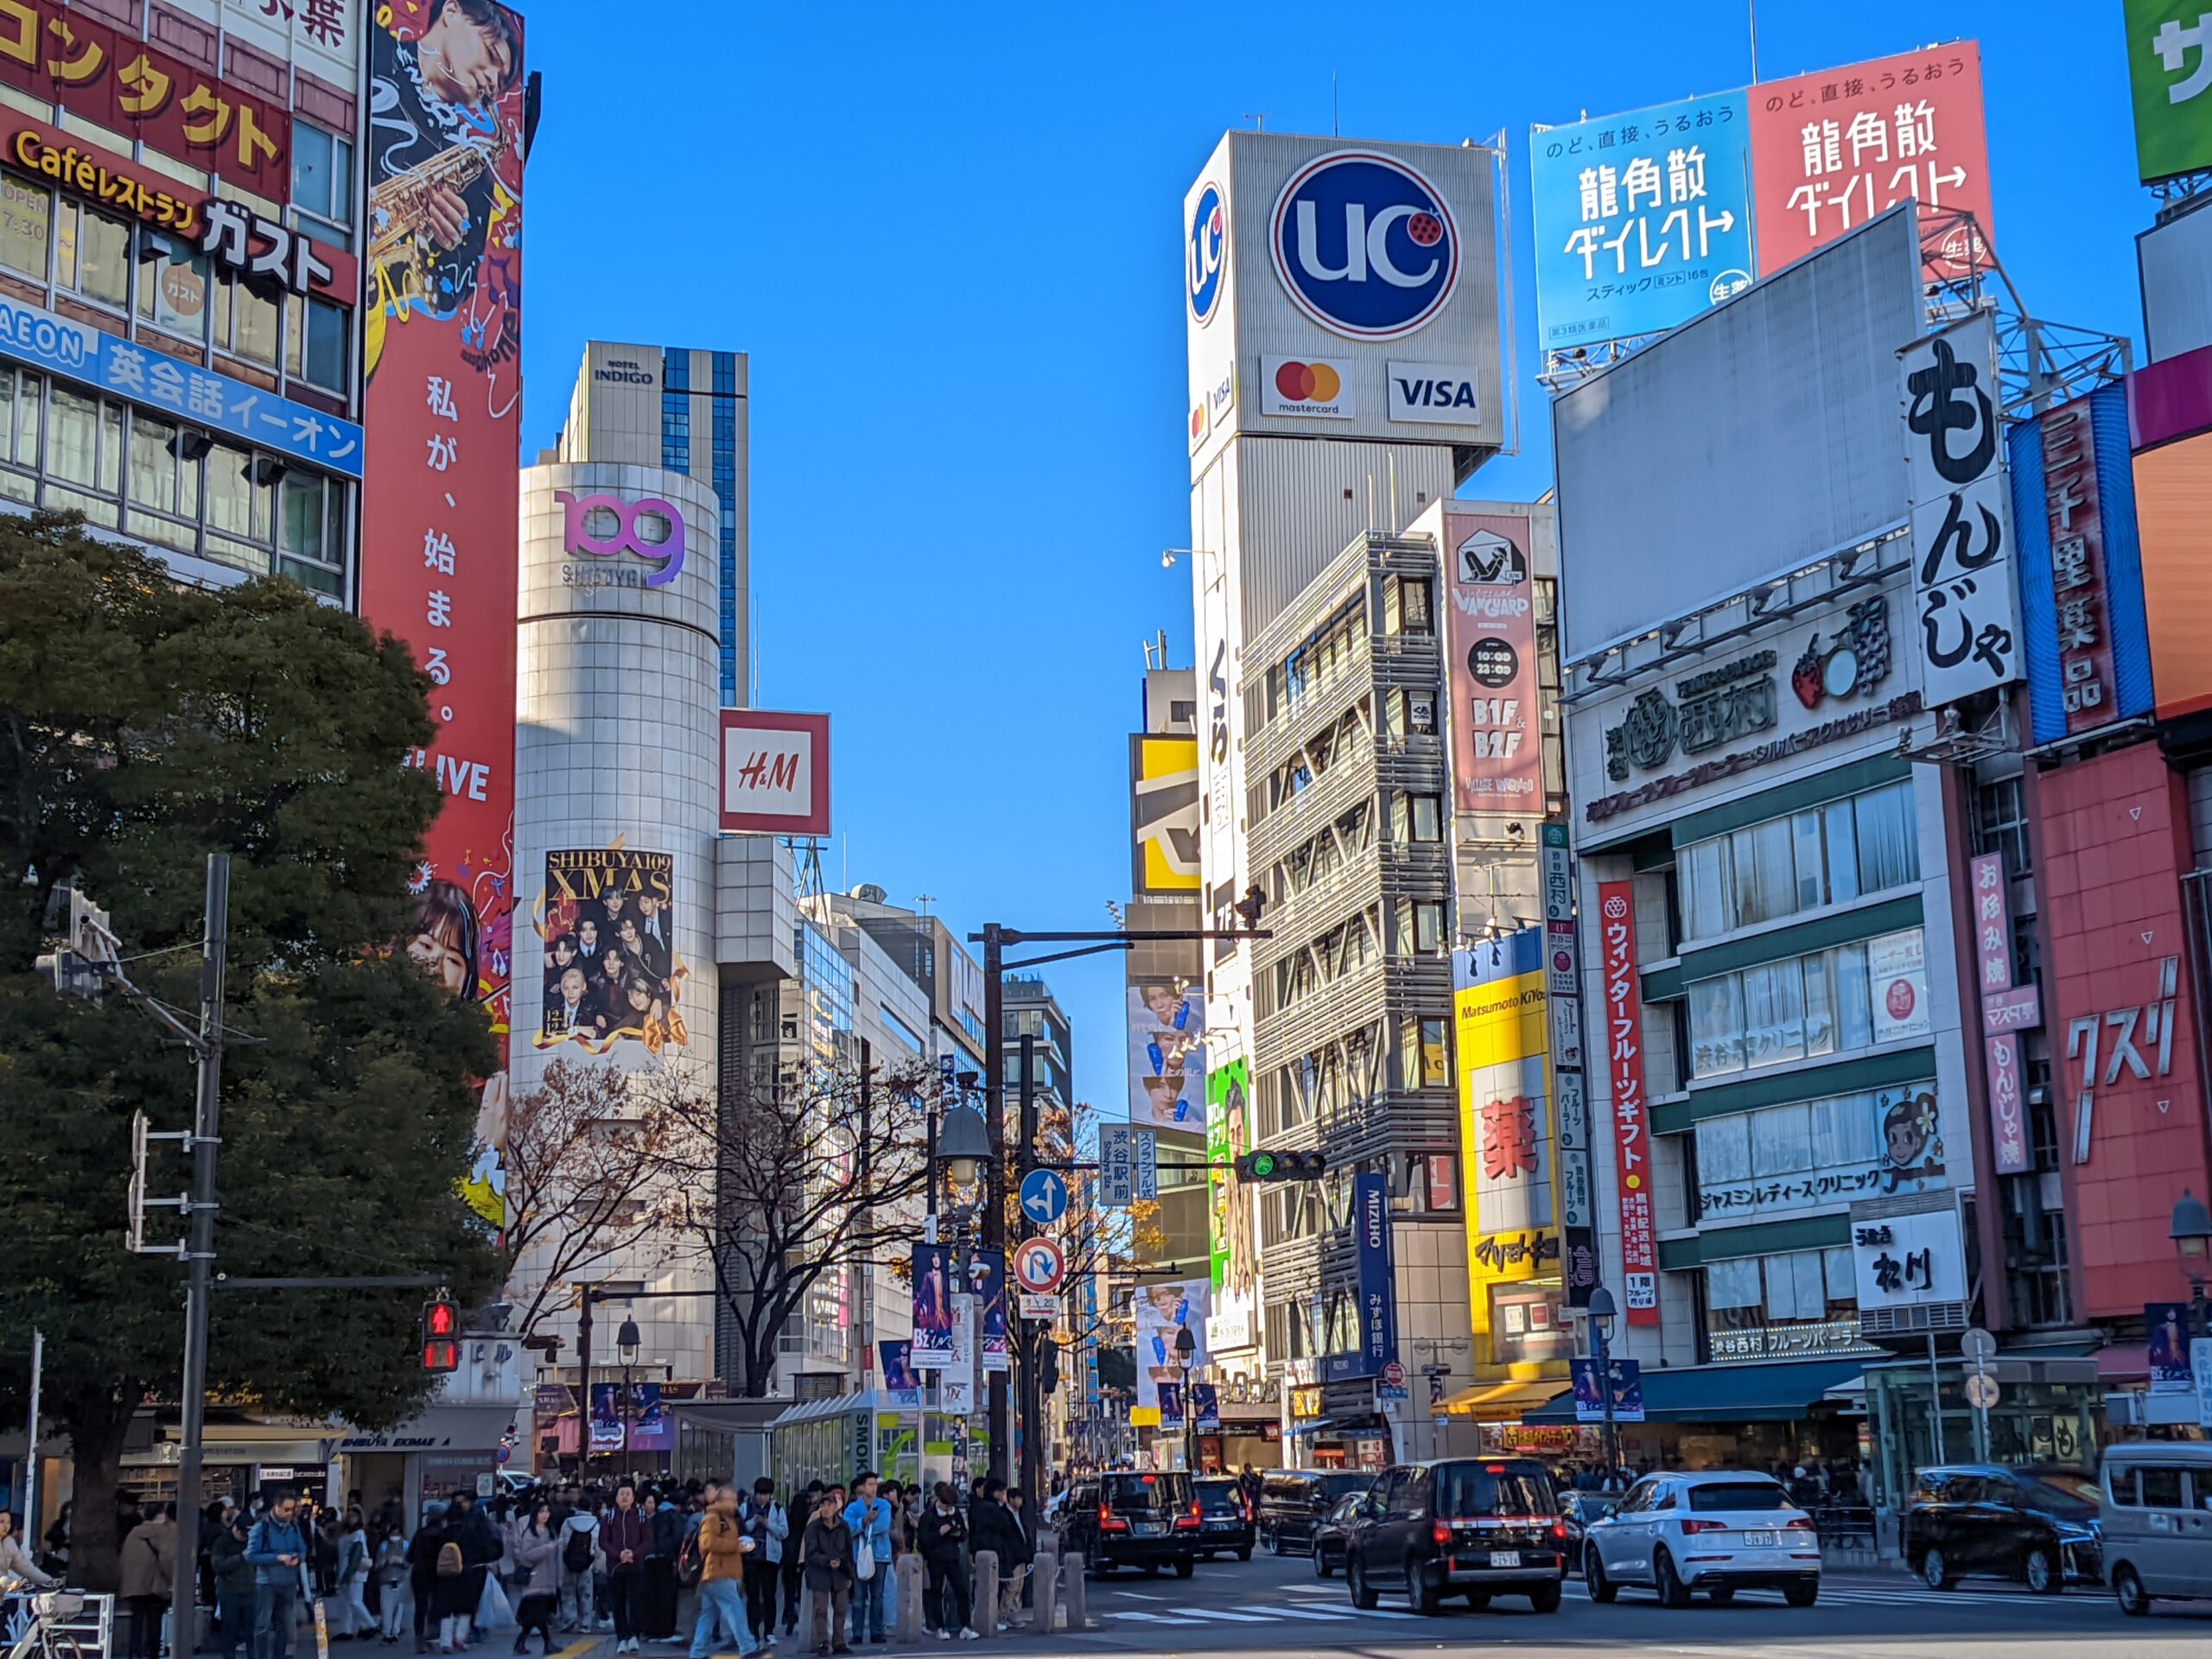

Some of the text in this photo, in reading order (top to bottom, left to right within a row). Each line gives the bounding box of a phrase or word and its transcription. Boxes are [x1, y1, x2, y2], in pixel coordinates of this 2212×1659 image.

[0, 0, 278, 167] コンタクト
[1766, 58, 1965, 113] のど、直接、うるおう
[1547, 105, 1734, 159] のど、直接、うるおう
[1801, 99, 1937, 178] 龍角散
[3, 183, 47, 213] OPEN
[1579, 144, 1707, 222] 龍角散
[3, 211, 46, 243] 7:30
[202, 200, 332, 293] ガスト
[1563, 204, 1735, 281] ダイレクト
[167, 282, 200, 304] ガスト
[1586, 276, 1652, 302] スティック
[0, 306, 83, 362] AEON
[594, 370, 653, 385] INDIGO
[607, 359, 639, 370] HOTEL
[108, 343, 356, 459] 英会話イーオン
[1213, 377, 1230, 410] VISA
[1279, 403, 1338, 415] mastercard
[1393, 378, 1476, 410] VISA
[1908, 339, 2012, 677] もんじゃ
[423, 375, 459, 721] 私が、始まる。
[554, 490, 685, 587] 109
[1473, 698, 1519, 726] B1F
[739, 751, 799, 792] H&M
[1474, 731, 1522, 760] B2F
[549, 850, 671, 872] SHIBUYA109
[549, 868, 671, 904] XMAS
[1979, 863, 2006, 984] お好み焼
[1607, 923, 1643, 1170] ウィンターフルーツギフト
[1994, 1040, 2021, 1166] もんじゃ焼
[1481, 1092, 1539, 1181] 薬
[1113, 1130, 1128, 1200] 渋谷駅前
[1140, 1132, 1154, 1199] スクランブル式
[1700, 1168, 1880, 1211] ジャスミンレディースクリニック
[1367, 1189, 1382, 1249] MIZUHO
[1872, 1248, 1933, 1294] 松川
[1370, 1293, 1384, 1358] みずほ銀行
